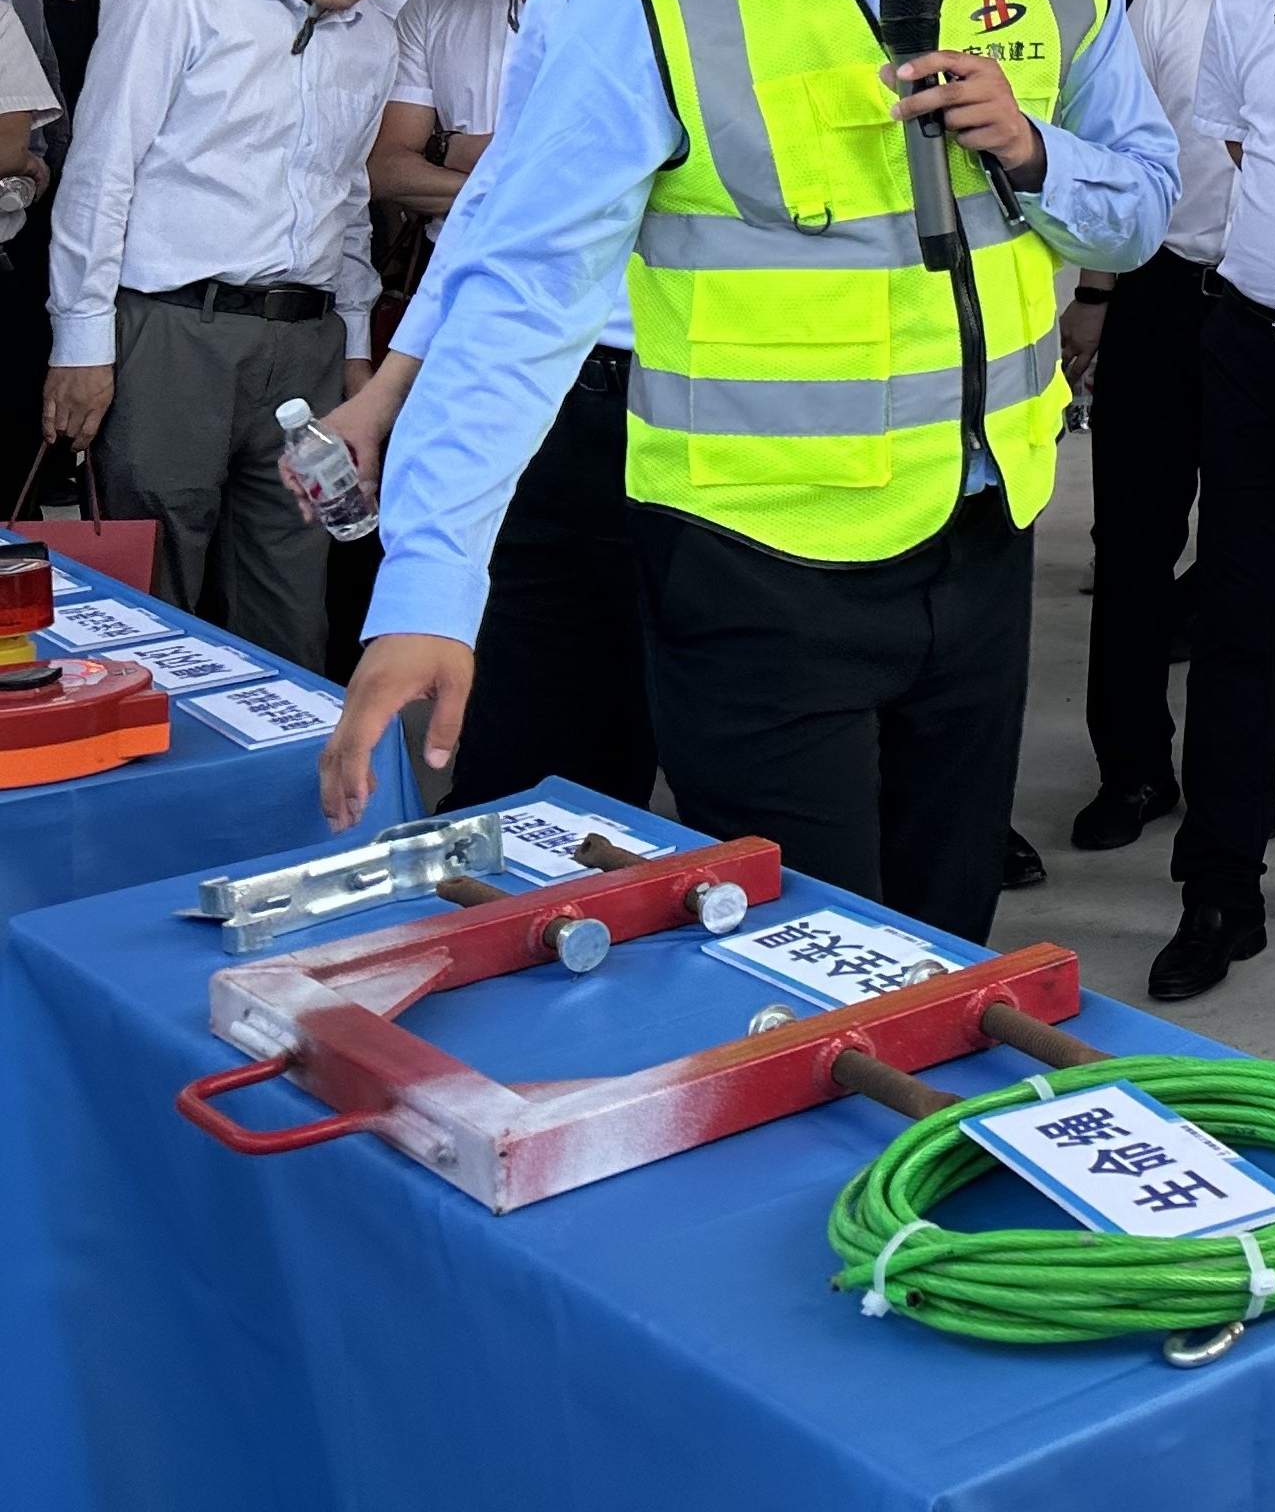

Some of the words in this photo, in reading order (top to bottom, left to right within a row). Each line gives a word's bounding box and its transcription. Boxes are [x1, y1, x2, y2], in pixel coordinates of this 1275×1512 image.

[133, 645, 232, 679] 爆闪灯
[1035, 1106, 1230, 1213] 生命绳
